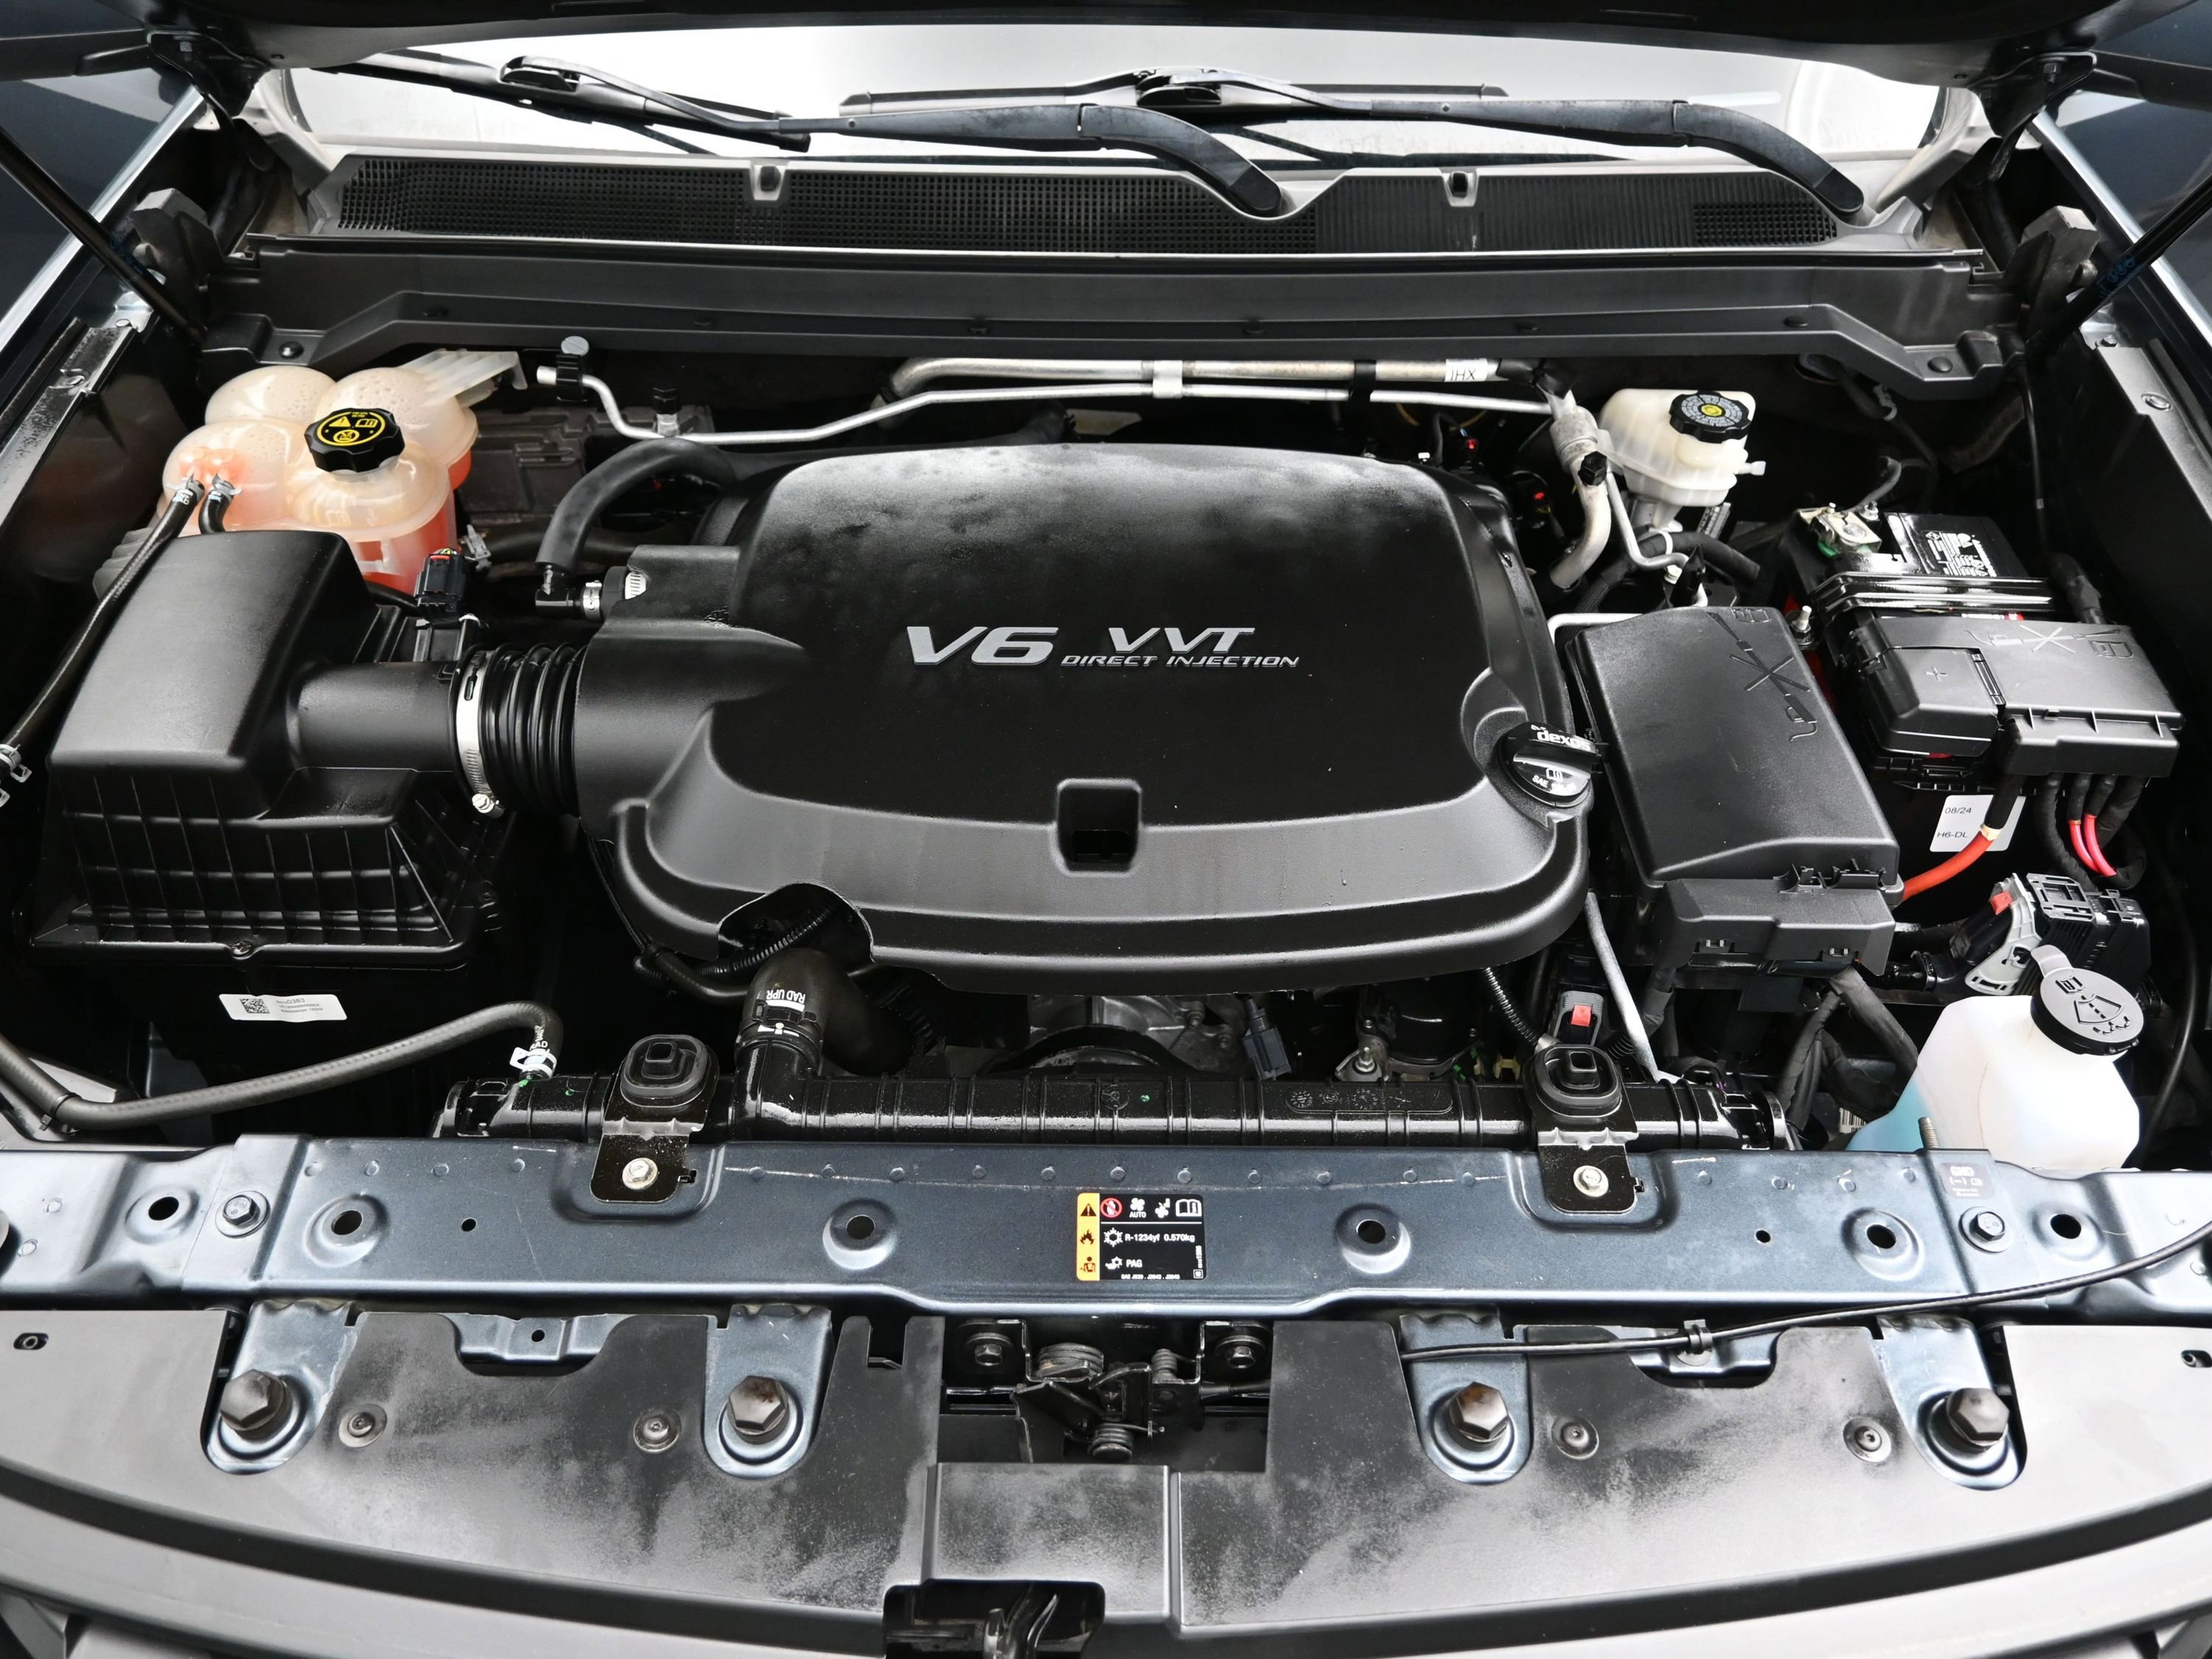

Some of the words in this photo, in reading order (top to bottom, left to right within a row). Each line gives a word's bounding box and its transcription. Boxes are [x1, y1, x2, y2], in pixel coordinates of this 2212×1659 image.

[906, 626, 1059, 665] V6
[1108, 627, 1255, 653] VVT
[1061, 655, 1158, 667] DIRECT
[1165, 655, 1300, 668] INJECTION
[1537, 729, 1591, 751] dexos
[1532, 774, 1549, 788] SAE
[766, 989, 785, 1000] UPR
[786, 990, 806, 1004] RAD
[1124, 1234, 1161, 1242] R-1234yf
[1164, 1234, 1195, 1242] 0.570kg
[1126, 1259, 1143, 1267] PAG
